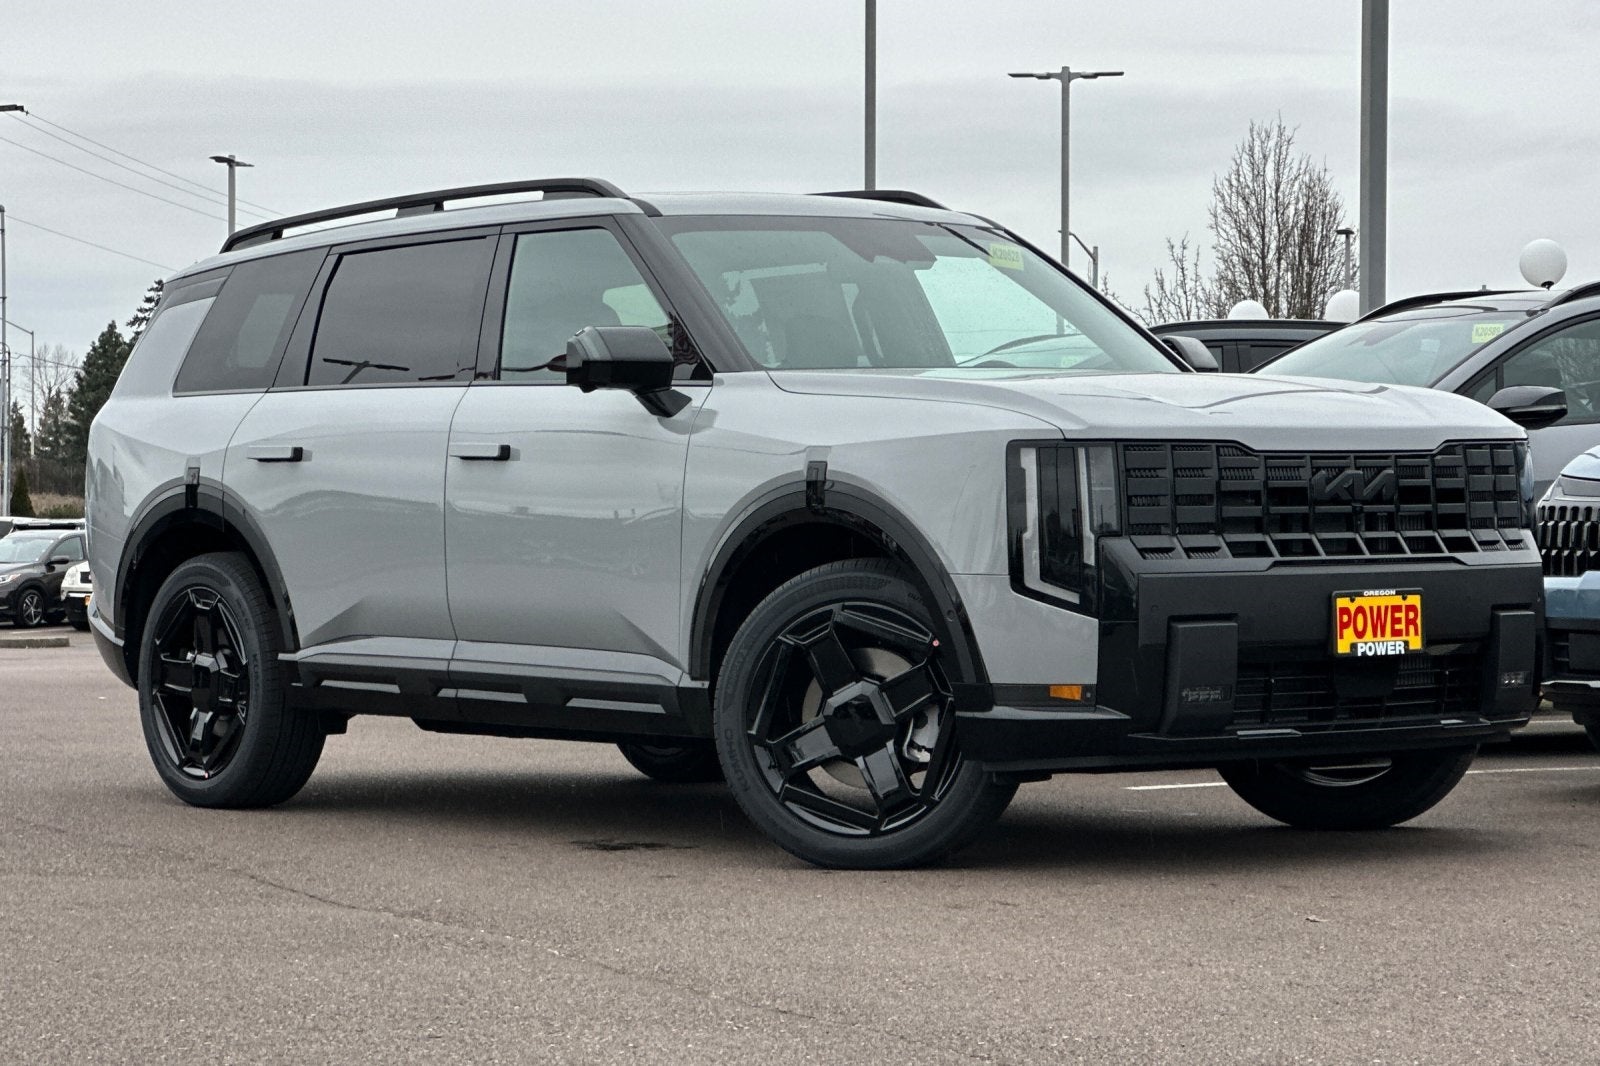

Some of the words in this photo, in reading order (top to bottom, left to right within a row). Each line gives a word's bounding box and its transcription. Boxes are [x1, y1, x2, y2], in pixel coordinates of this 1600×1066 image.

[1311, 469, 1395, 501] KIA
[1363, 589, 1396, 597] OREGON
[1338, 604, 1420, 640] POWER
[1357, 641, 1405, 657] POWER
